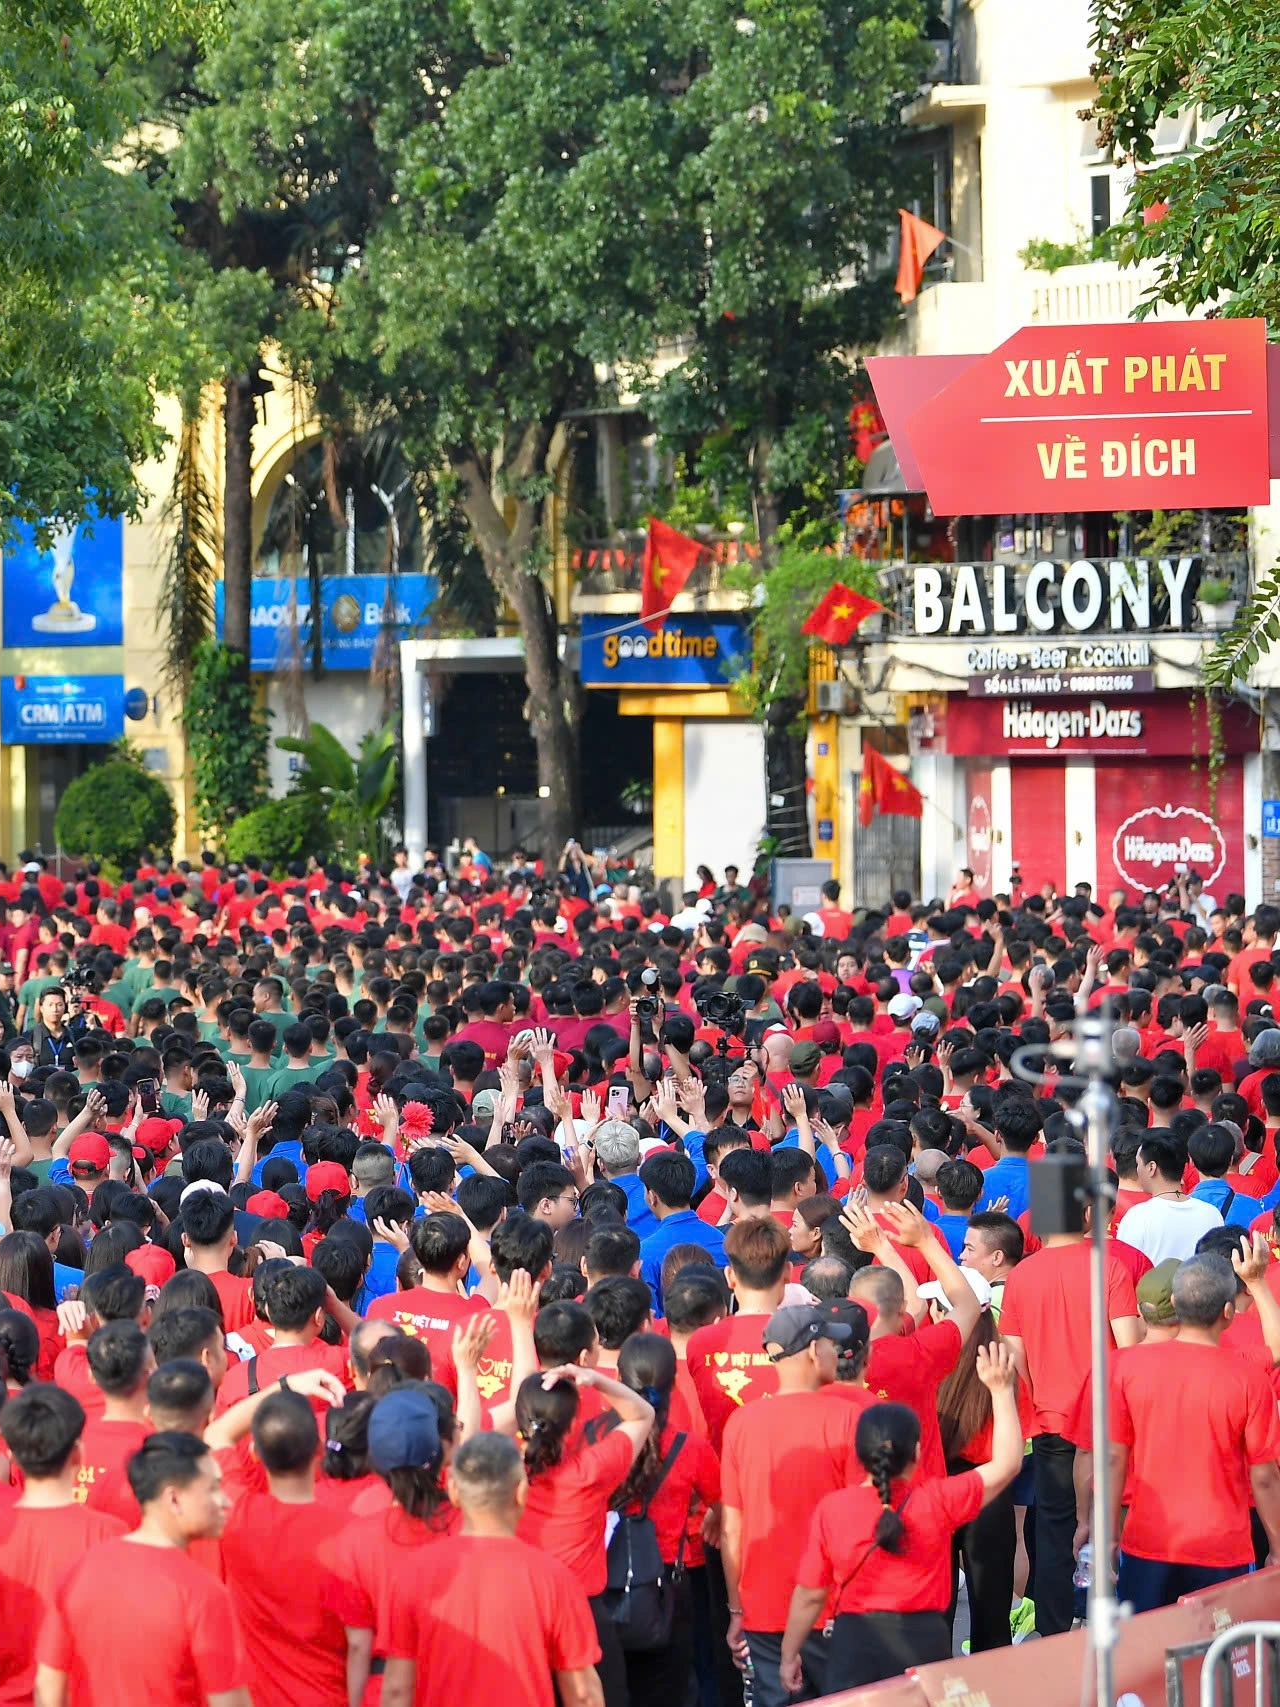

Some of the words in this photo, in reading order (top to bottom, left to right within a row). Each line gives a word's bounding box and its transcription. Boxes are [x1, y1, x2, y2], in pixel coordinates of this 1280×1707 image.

[1004, 350, 1109, 397] XUẤT
[1125, 348, 1226, 393] PHÁT
[1037, 433, 1087, 479] VỀ
[1101, 432, 1195, 478] ĐÍCH
[914, 559, 1193, 634] BALCONY
[603, 628, 718, 668] goodtime
[1031, 647, 1068, 669] Beer
[1080, 642, 1150, 668] Cocktail
[21, 703, 59, 724] CRM
[64, 703, 103, 723] ATM
[705, 1354, 711, 1366] I
